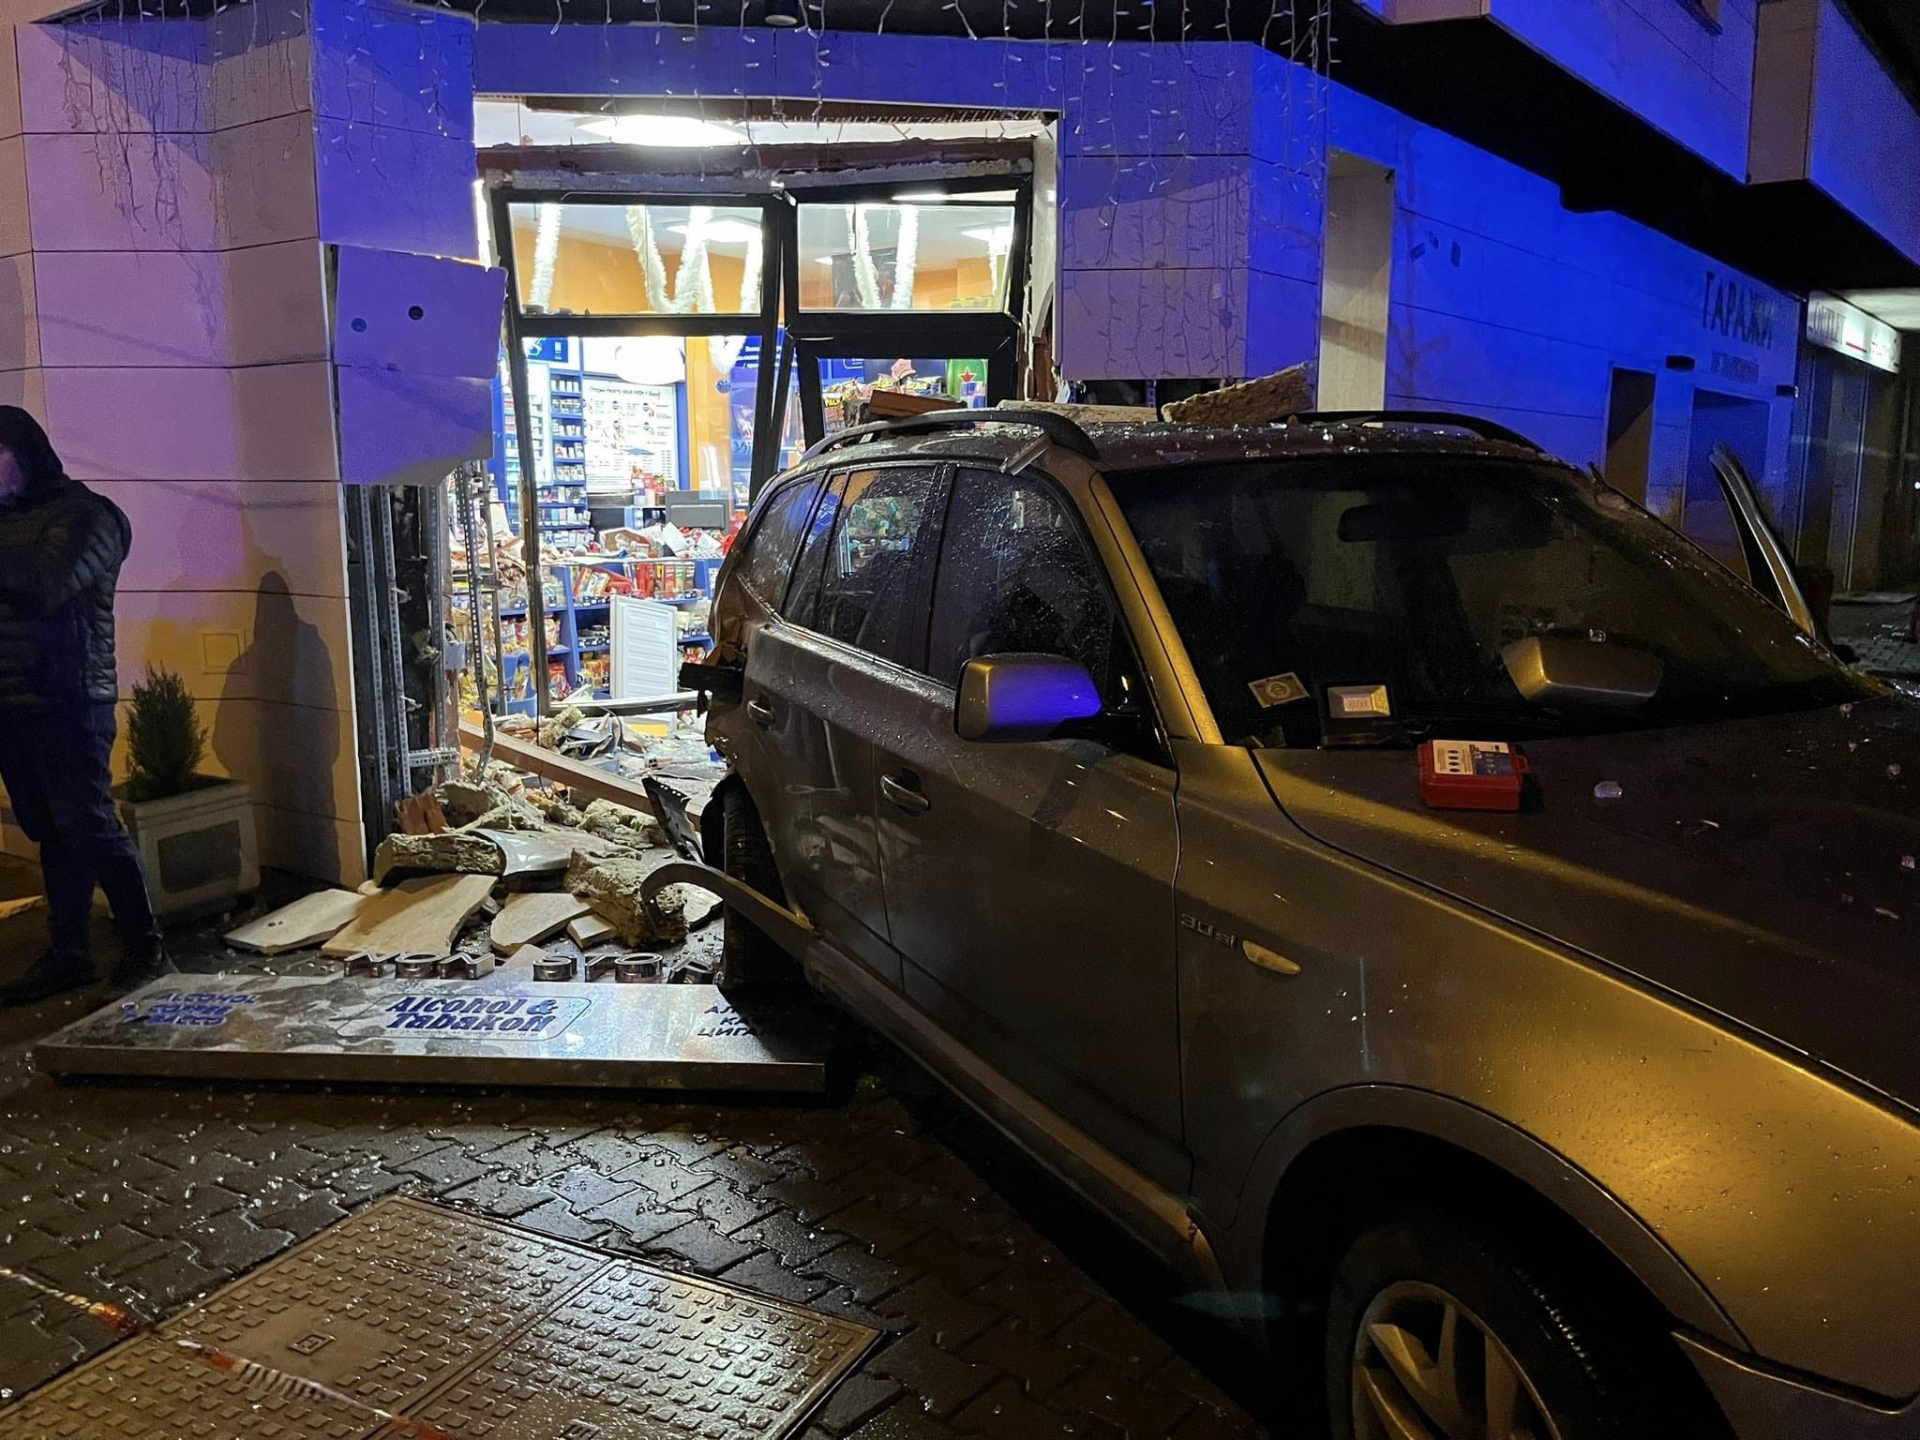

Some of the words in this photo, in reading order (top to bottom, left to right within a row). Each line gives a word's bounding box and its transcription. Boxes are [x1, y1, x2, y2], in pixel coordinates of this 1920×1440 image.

[386, 997, 521, 1014] Alcohol
[526, 1000, 559, 1015] &
[387, 1013, 556, 1031] Tabakoff
